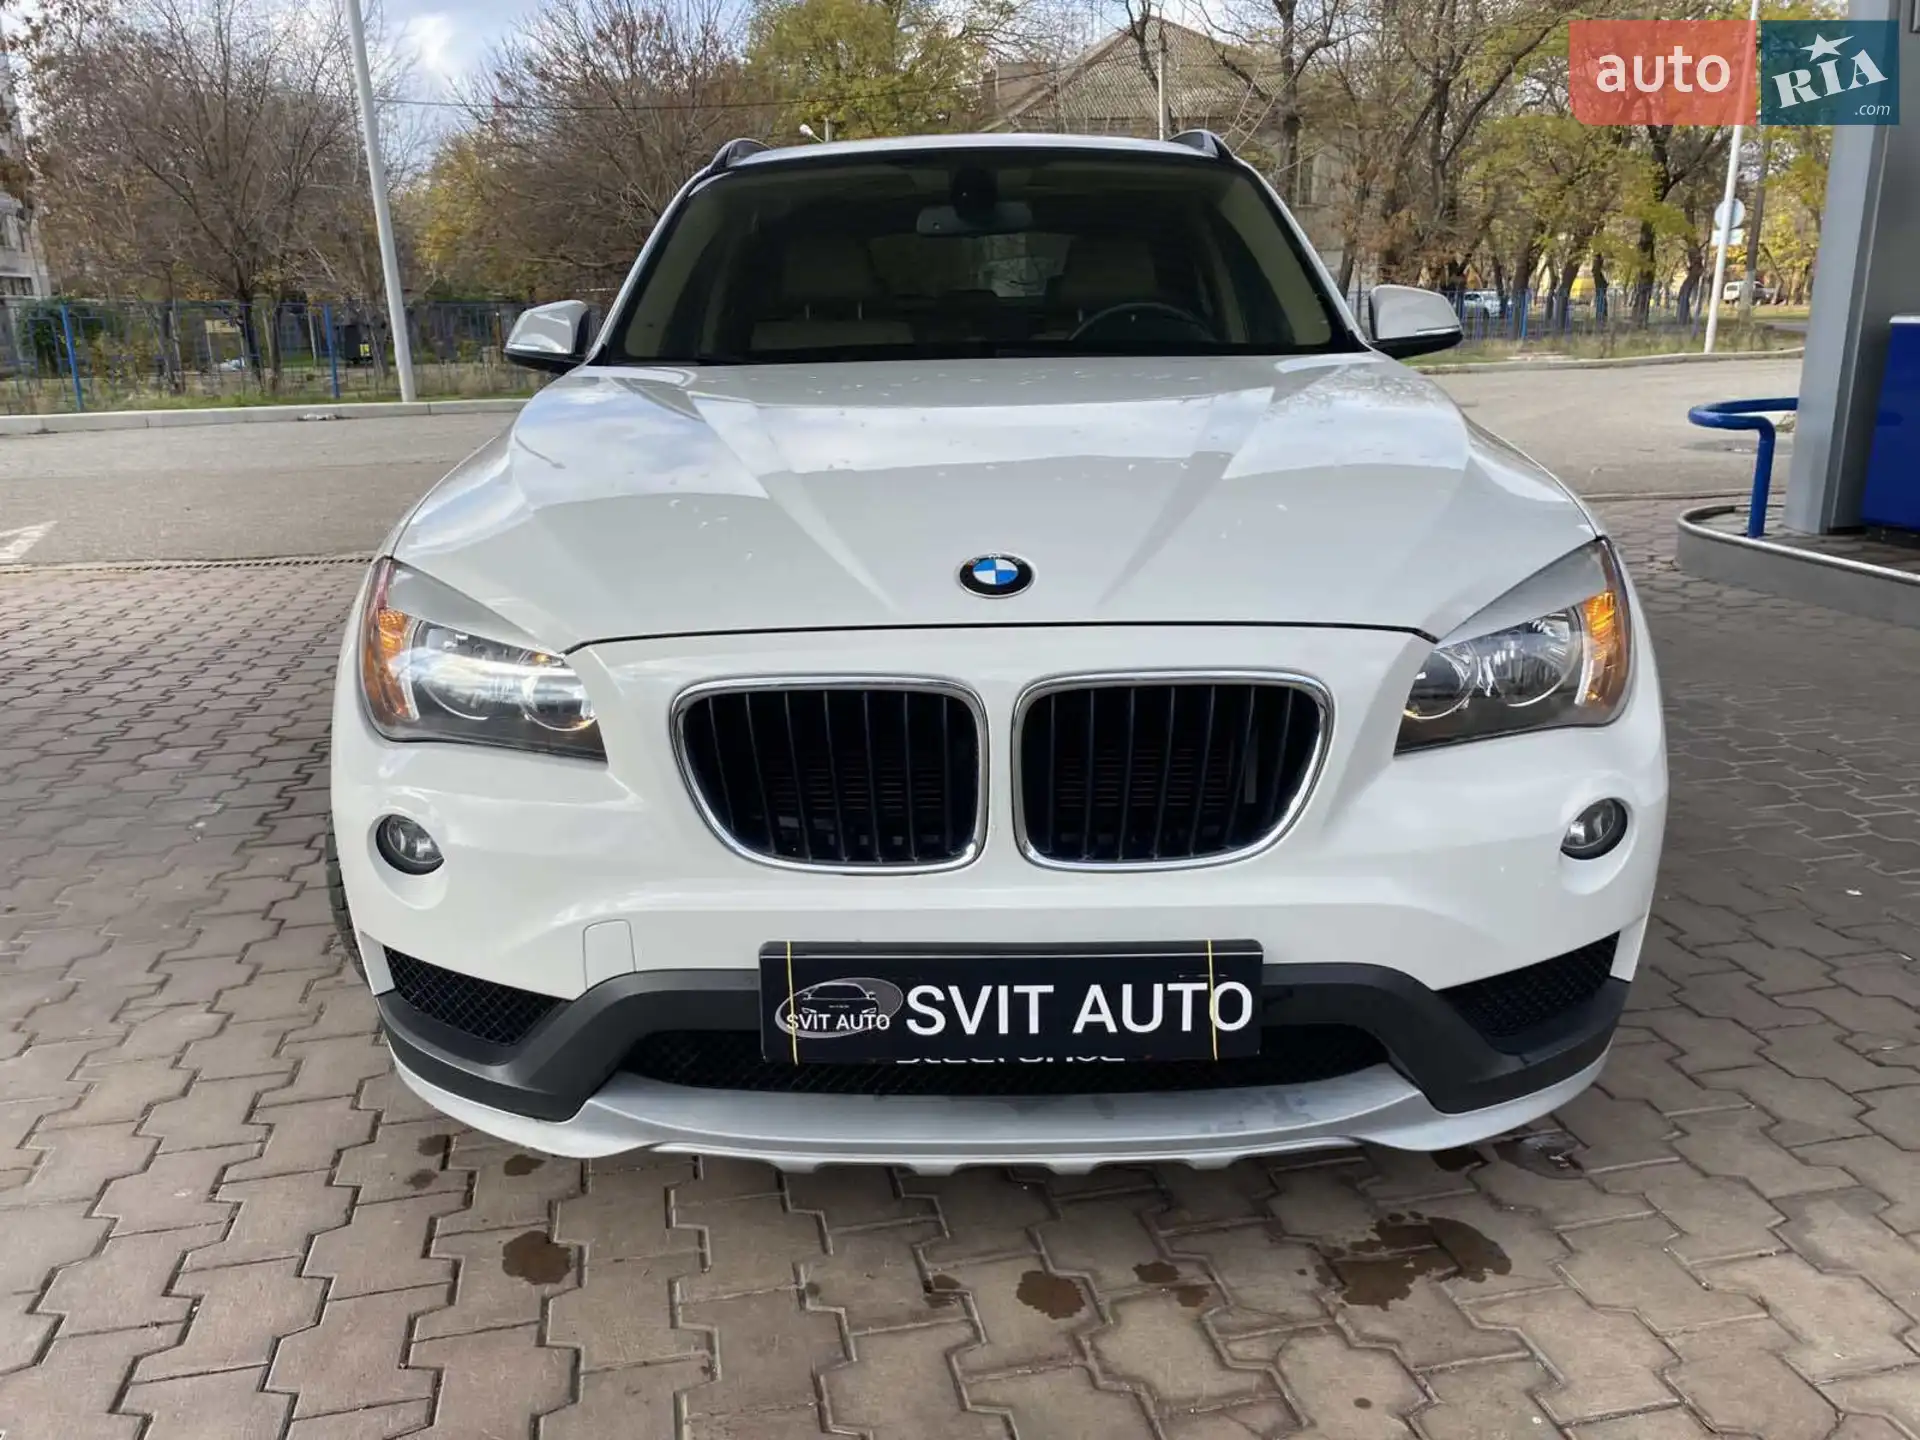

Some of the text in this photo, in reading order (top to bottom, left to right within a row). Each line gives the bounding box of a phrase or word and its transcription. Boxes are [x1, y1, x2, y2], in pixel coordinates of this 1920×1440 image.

[786, 1013, 890, 1031] SVIT AUTO
[906, 981, 1254, 1036] SVIT AUTO
